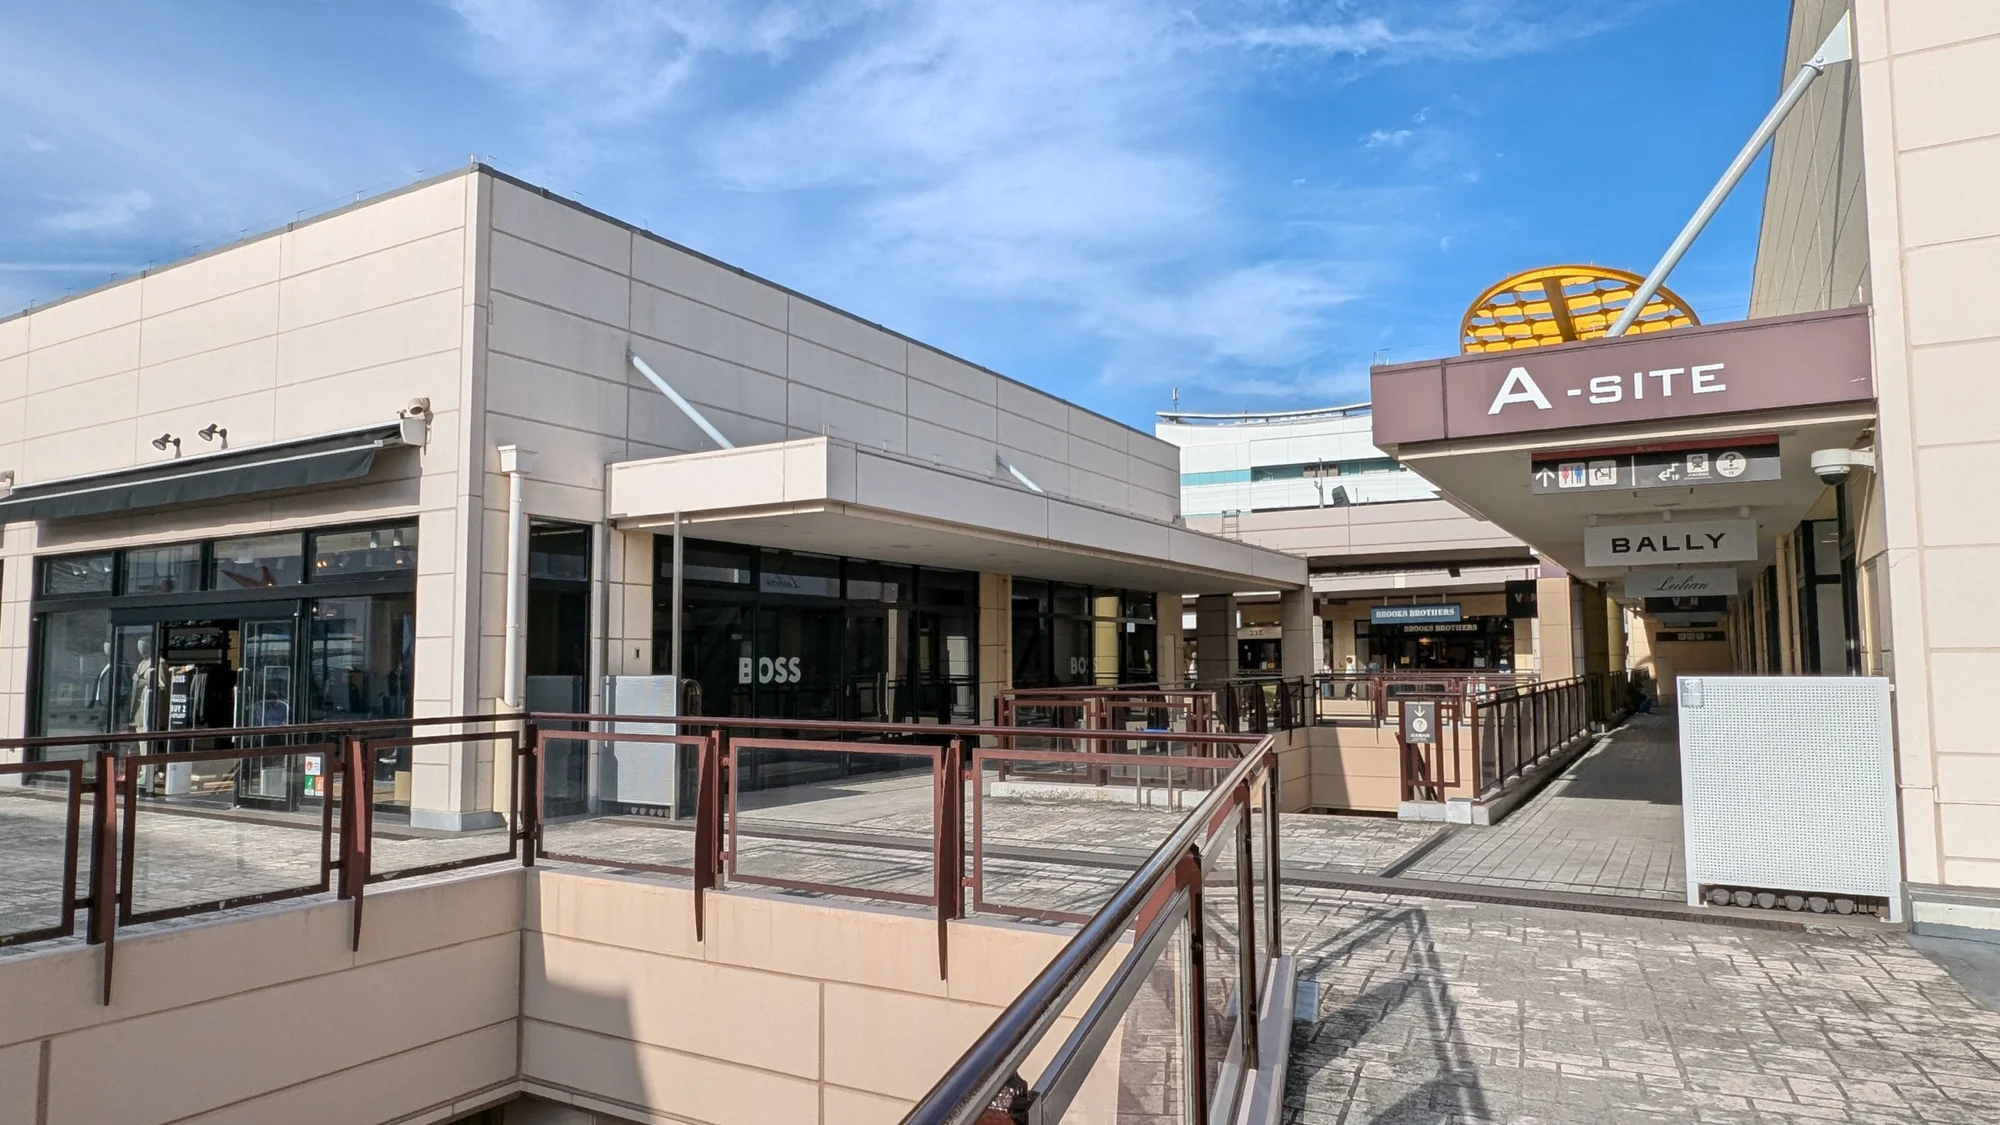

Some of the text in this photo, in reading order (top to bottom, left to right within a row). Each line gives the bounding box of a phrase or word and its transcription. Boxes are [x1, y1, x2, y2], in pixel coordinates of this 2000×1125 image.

[1611, 532, 1727, 554] BALLY
[1655, 575, 1708, 591] Leilian
[1376, 608, 1455, 619] BROOKS BROTHERS
[1404, 623, 1478, 632] BROOKS BROTHERS
[738, 656, 802, 684] BOSS
